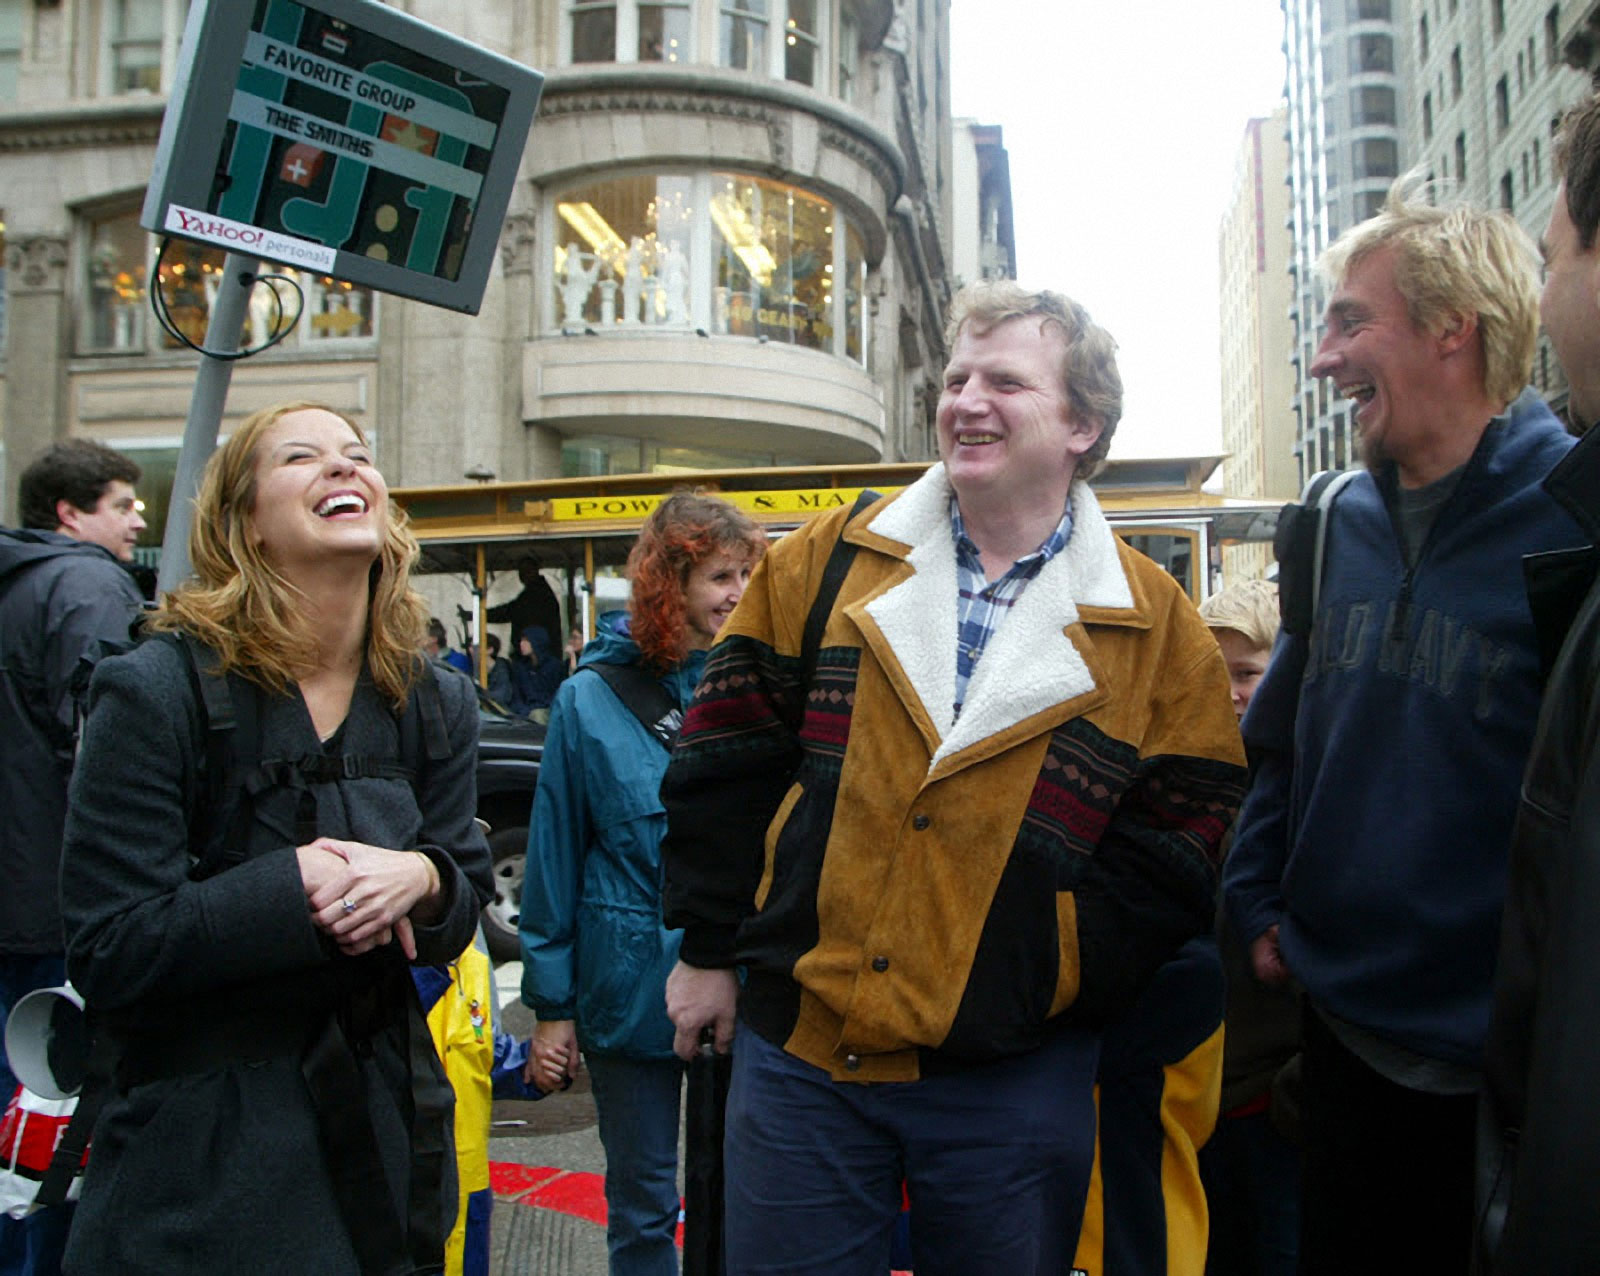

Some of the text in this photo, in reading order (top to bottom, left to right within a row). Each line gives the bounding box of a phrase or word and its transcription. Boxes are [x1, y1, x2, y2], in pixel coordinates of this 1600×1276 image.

[263, 45, 416, 113] FAVORITE GROUP
[265, 106, 374, 158] THE SMITHS
[175, 208, 330, 265] YAHOO! personals
[574, 493, 845, 516] POW & MA
